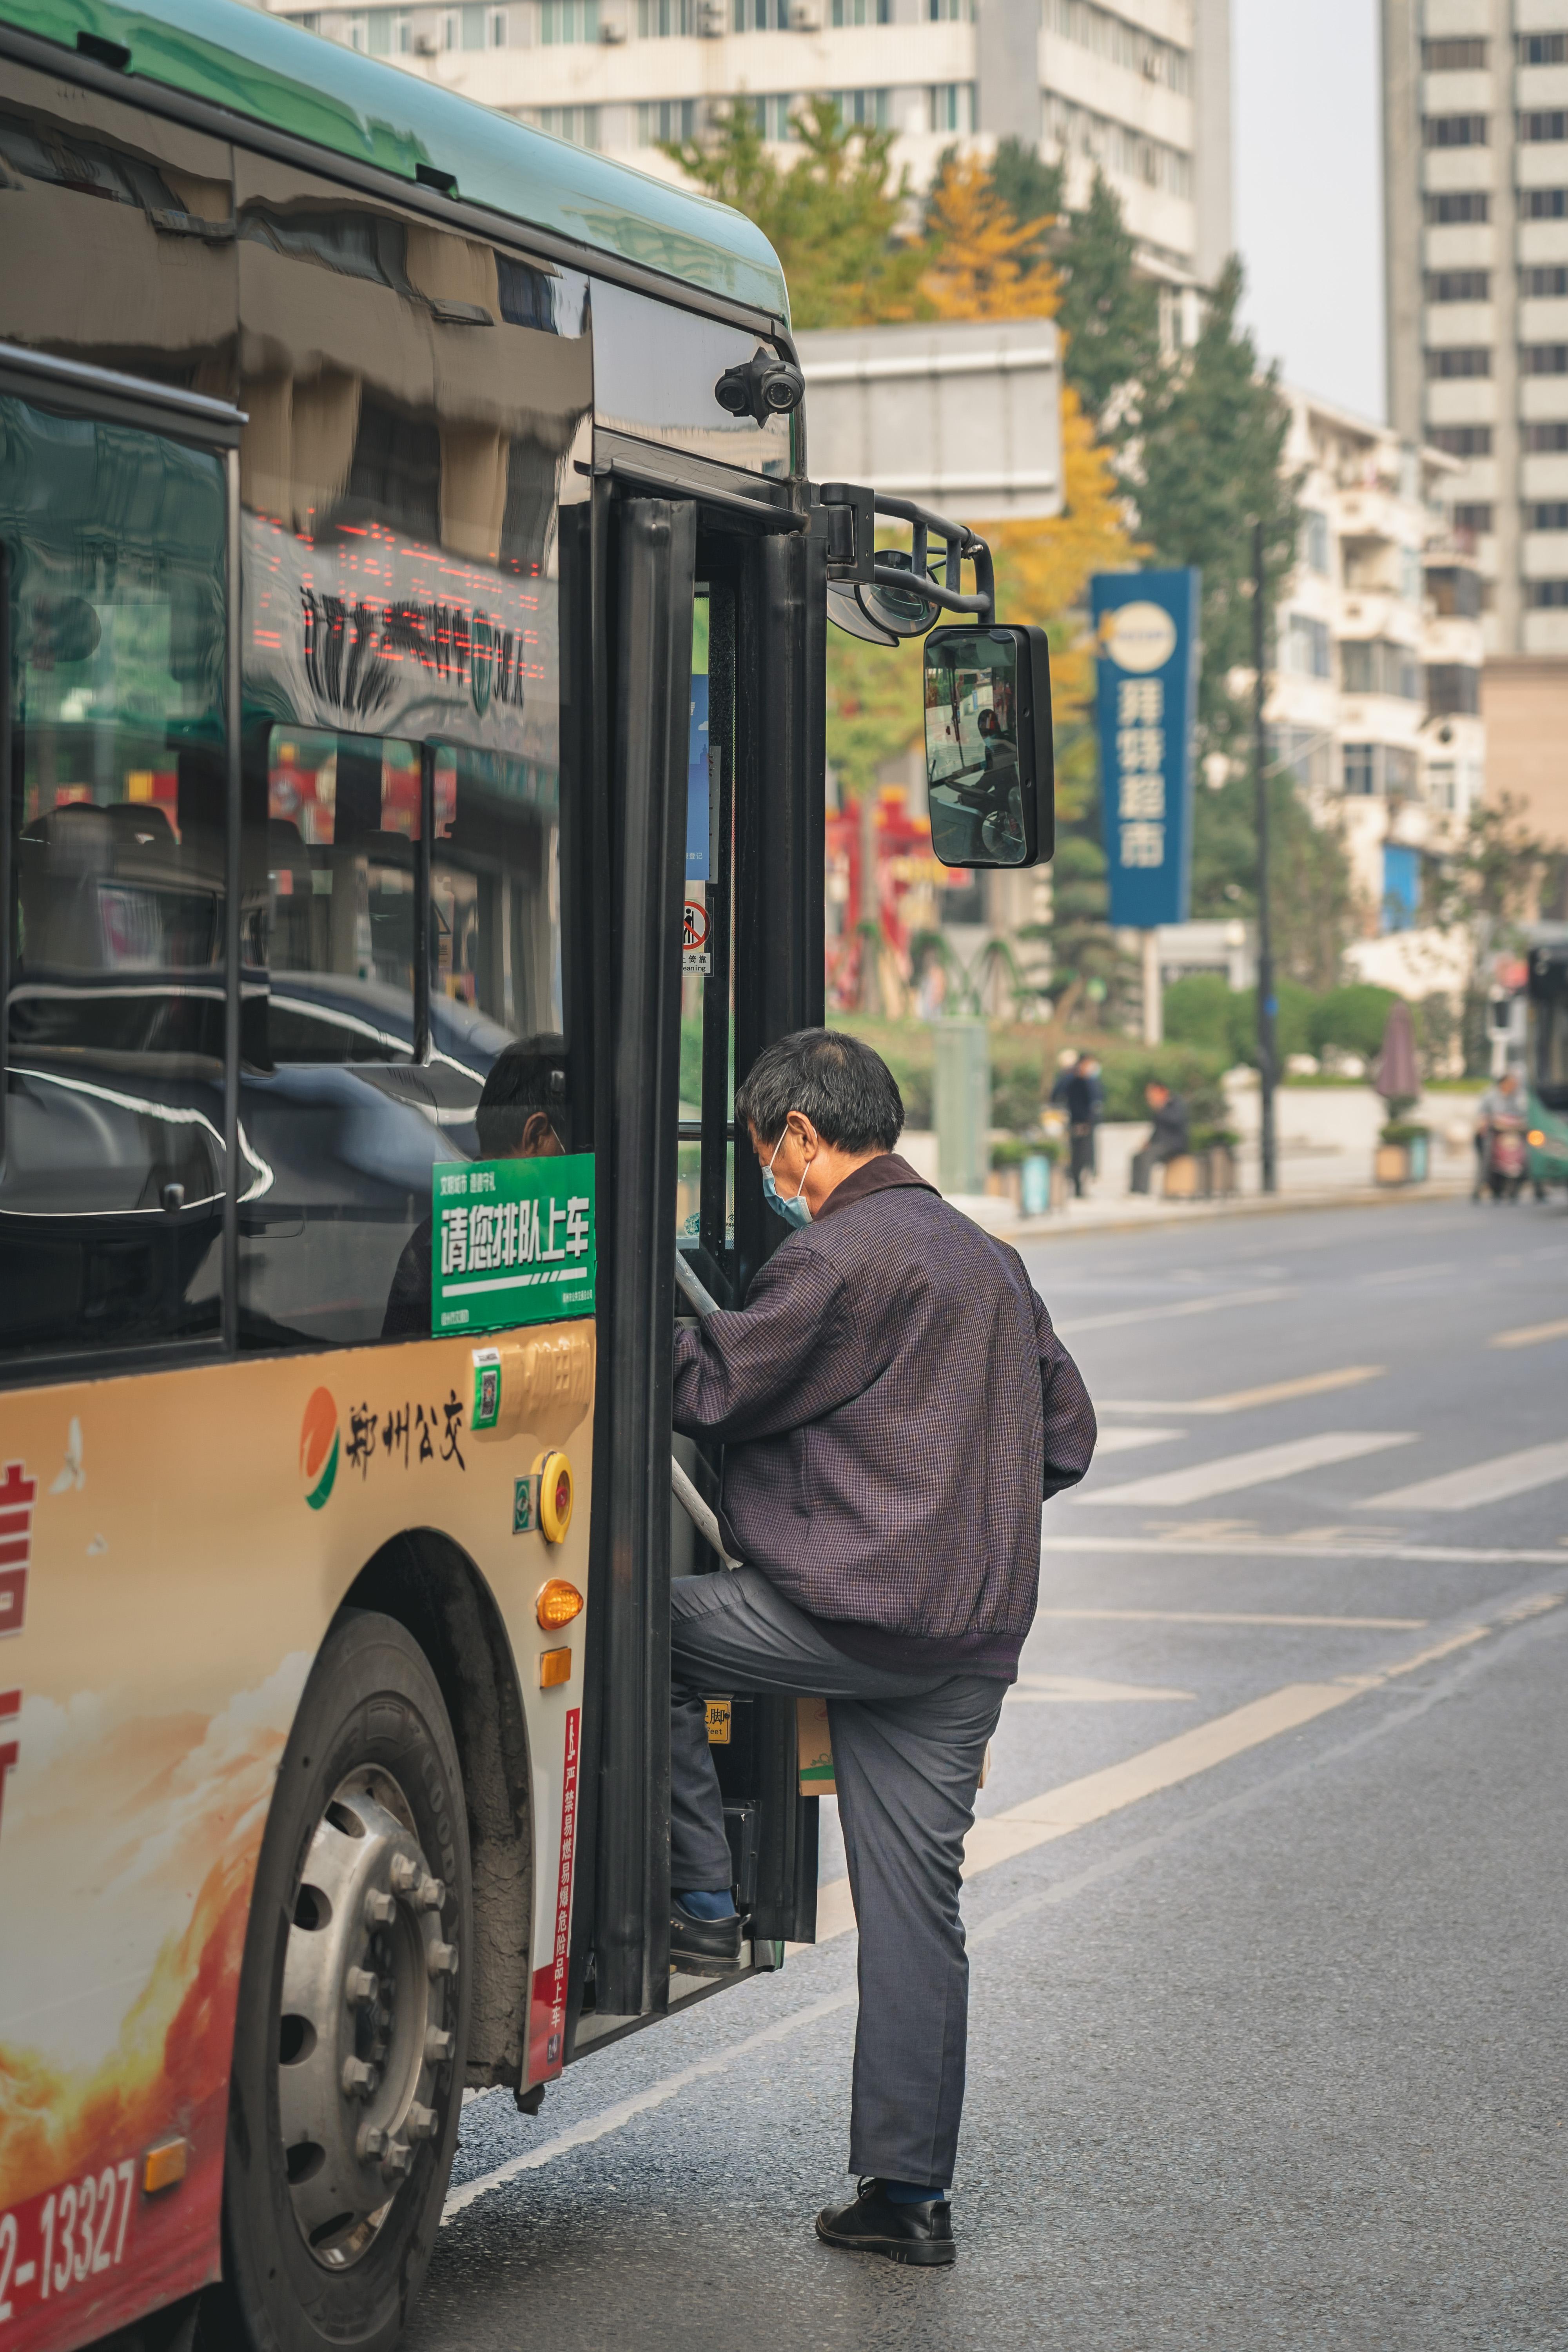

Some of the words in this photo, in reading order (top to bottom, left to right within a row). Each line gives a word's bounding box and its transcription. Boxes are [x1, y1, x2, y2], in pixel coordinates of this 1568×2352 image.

[441, 1196, 589, 1275] 请您排队上车
[345, 1389, 465, 1482] 郑州公交
[550, 1766, 576, 2029] 严禁易燃易爆危险品上车
